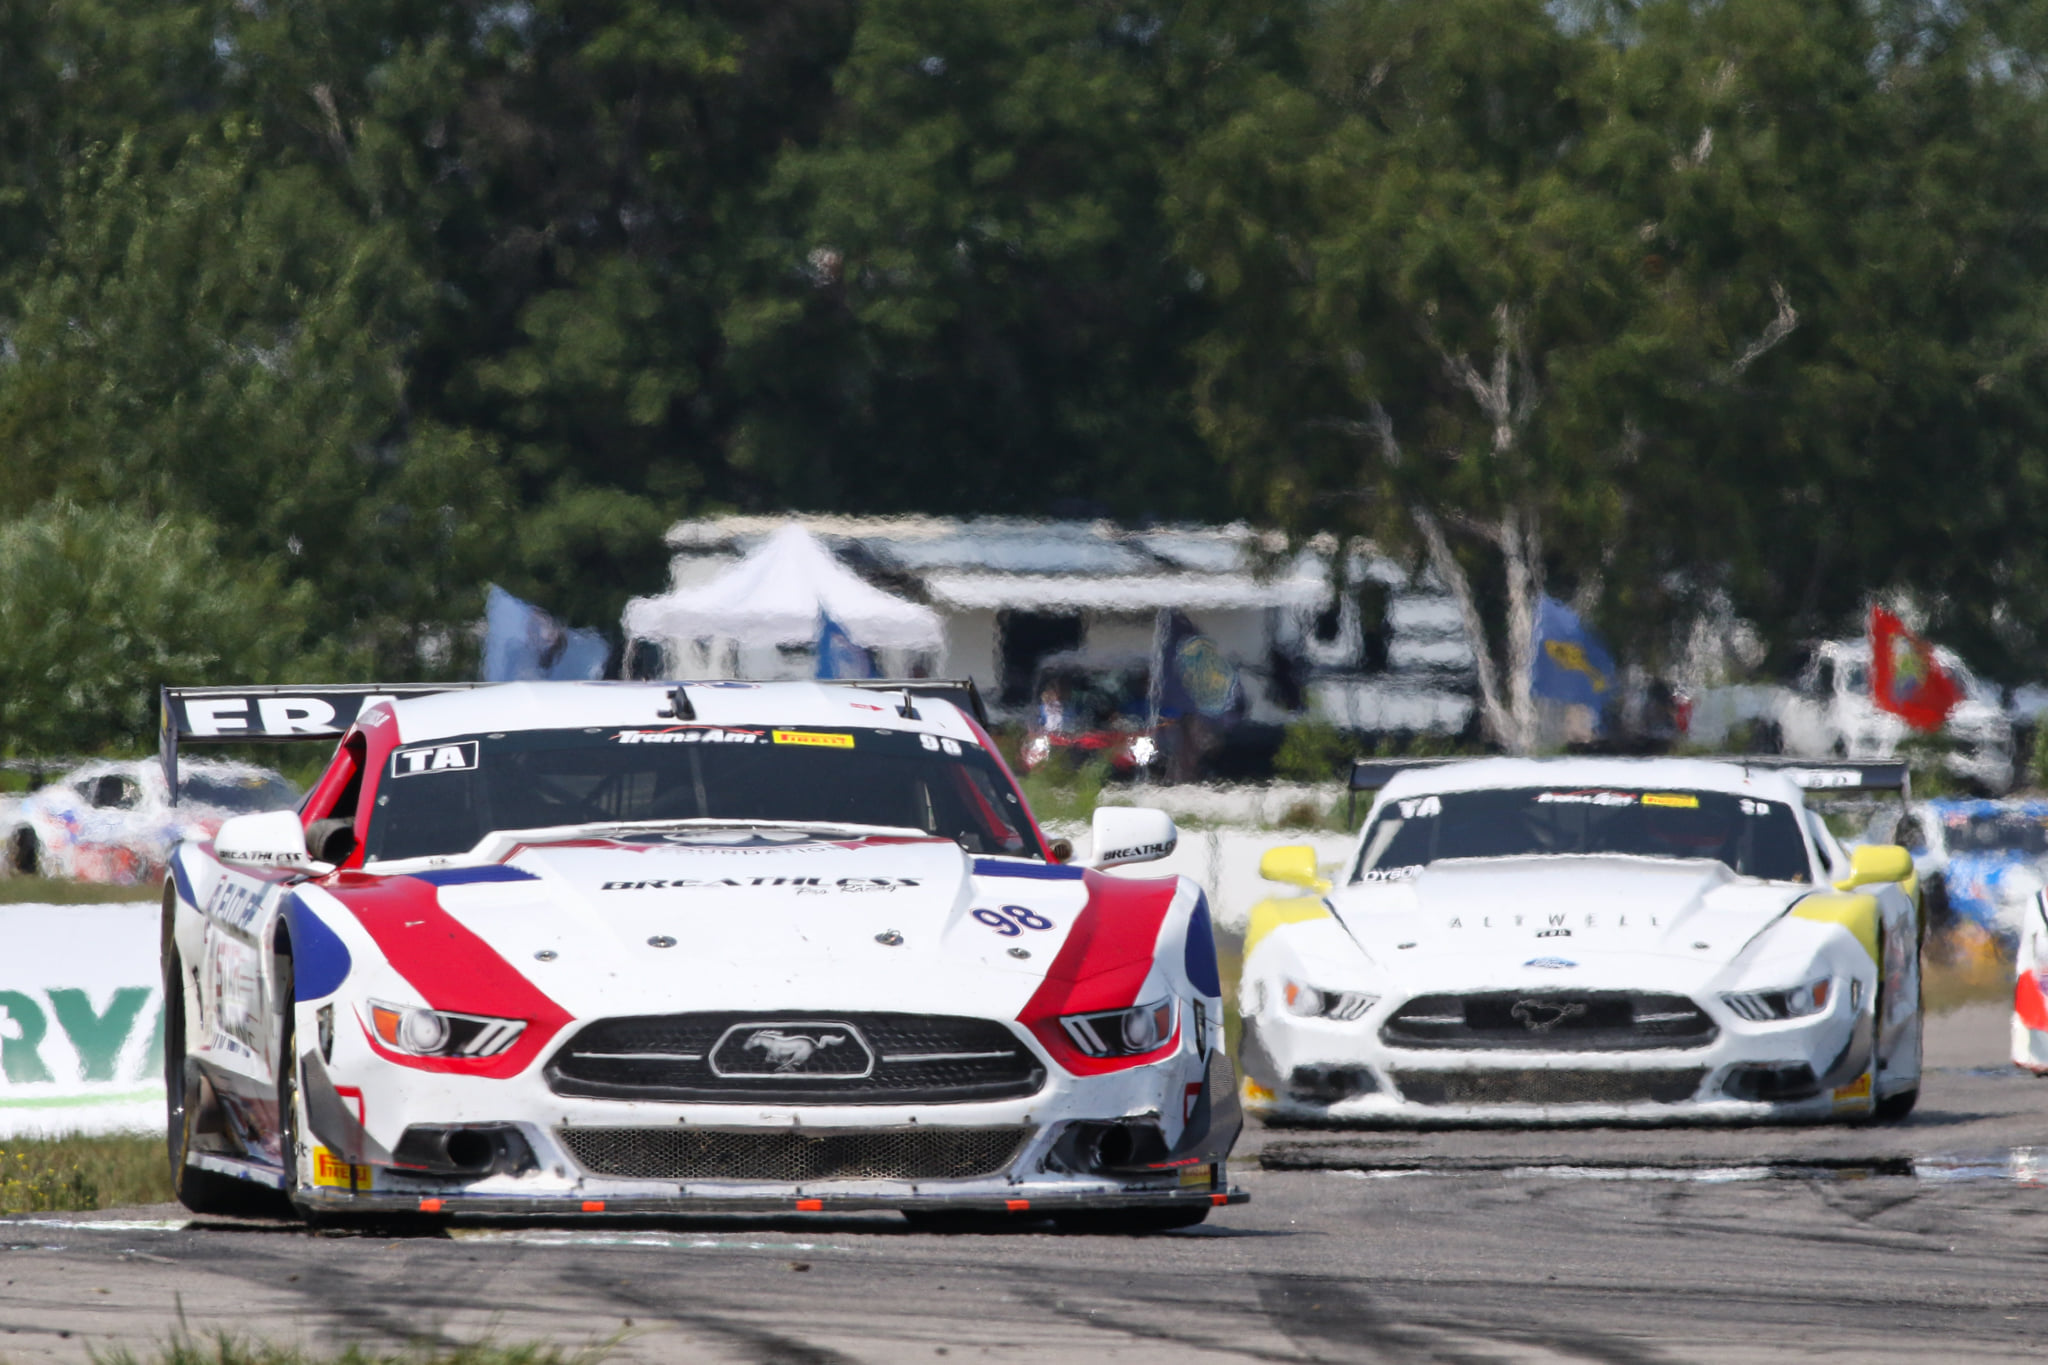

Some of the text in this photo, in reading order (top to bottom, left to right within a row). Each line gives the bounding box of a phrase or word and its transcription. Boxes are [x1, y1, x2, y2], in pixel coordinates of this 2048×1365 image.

[402, 746, 466, 773] TA
[601, 876, 924, 890] BREATHLESS
[970, 904, 1057, 937] 98
[0, 986, 165, 1083] RY
